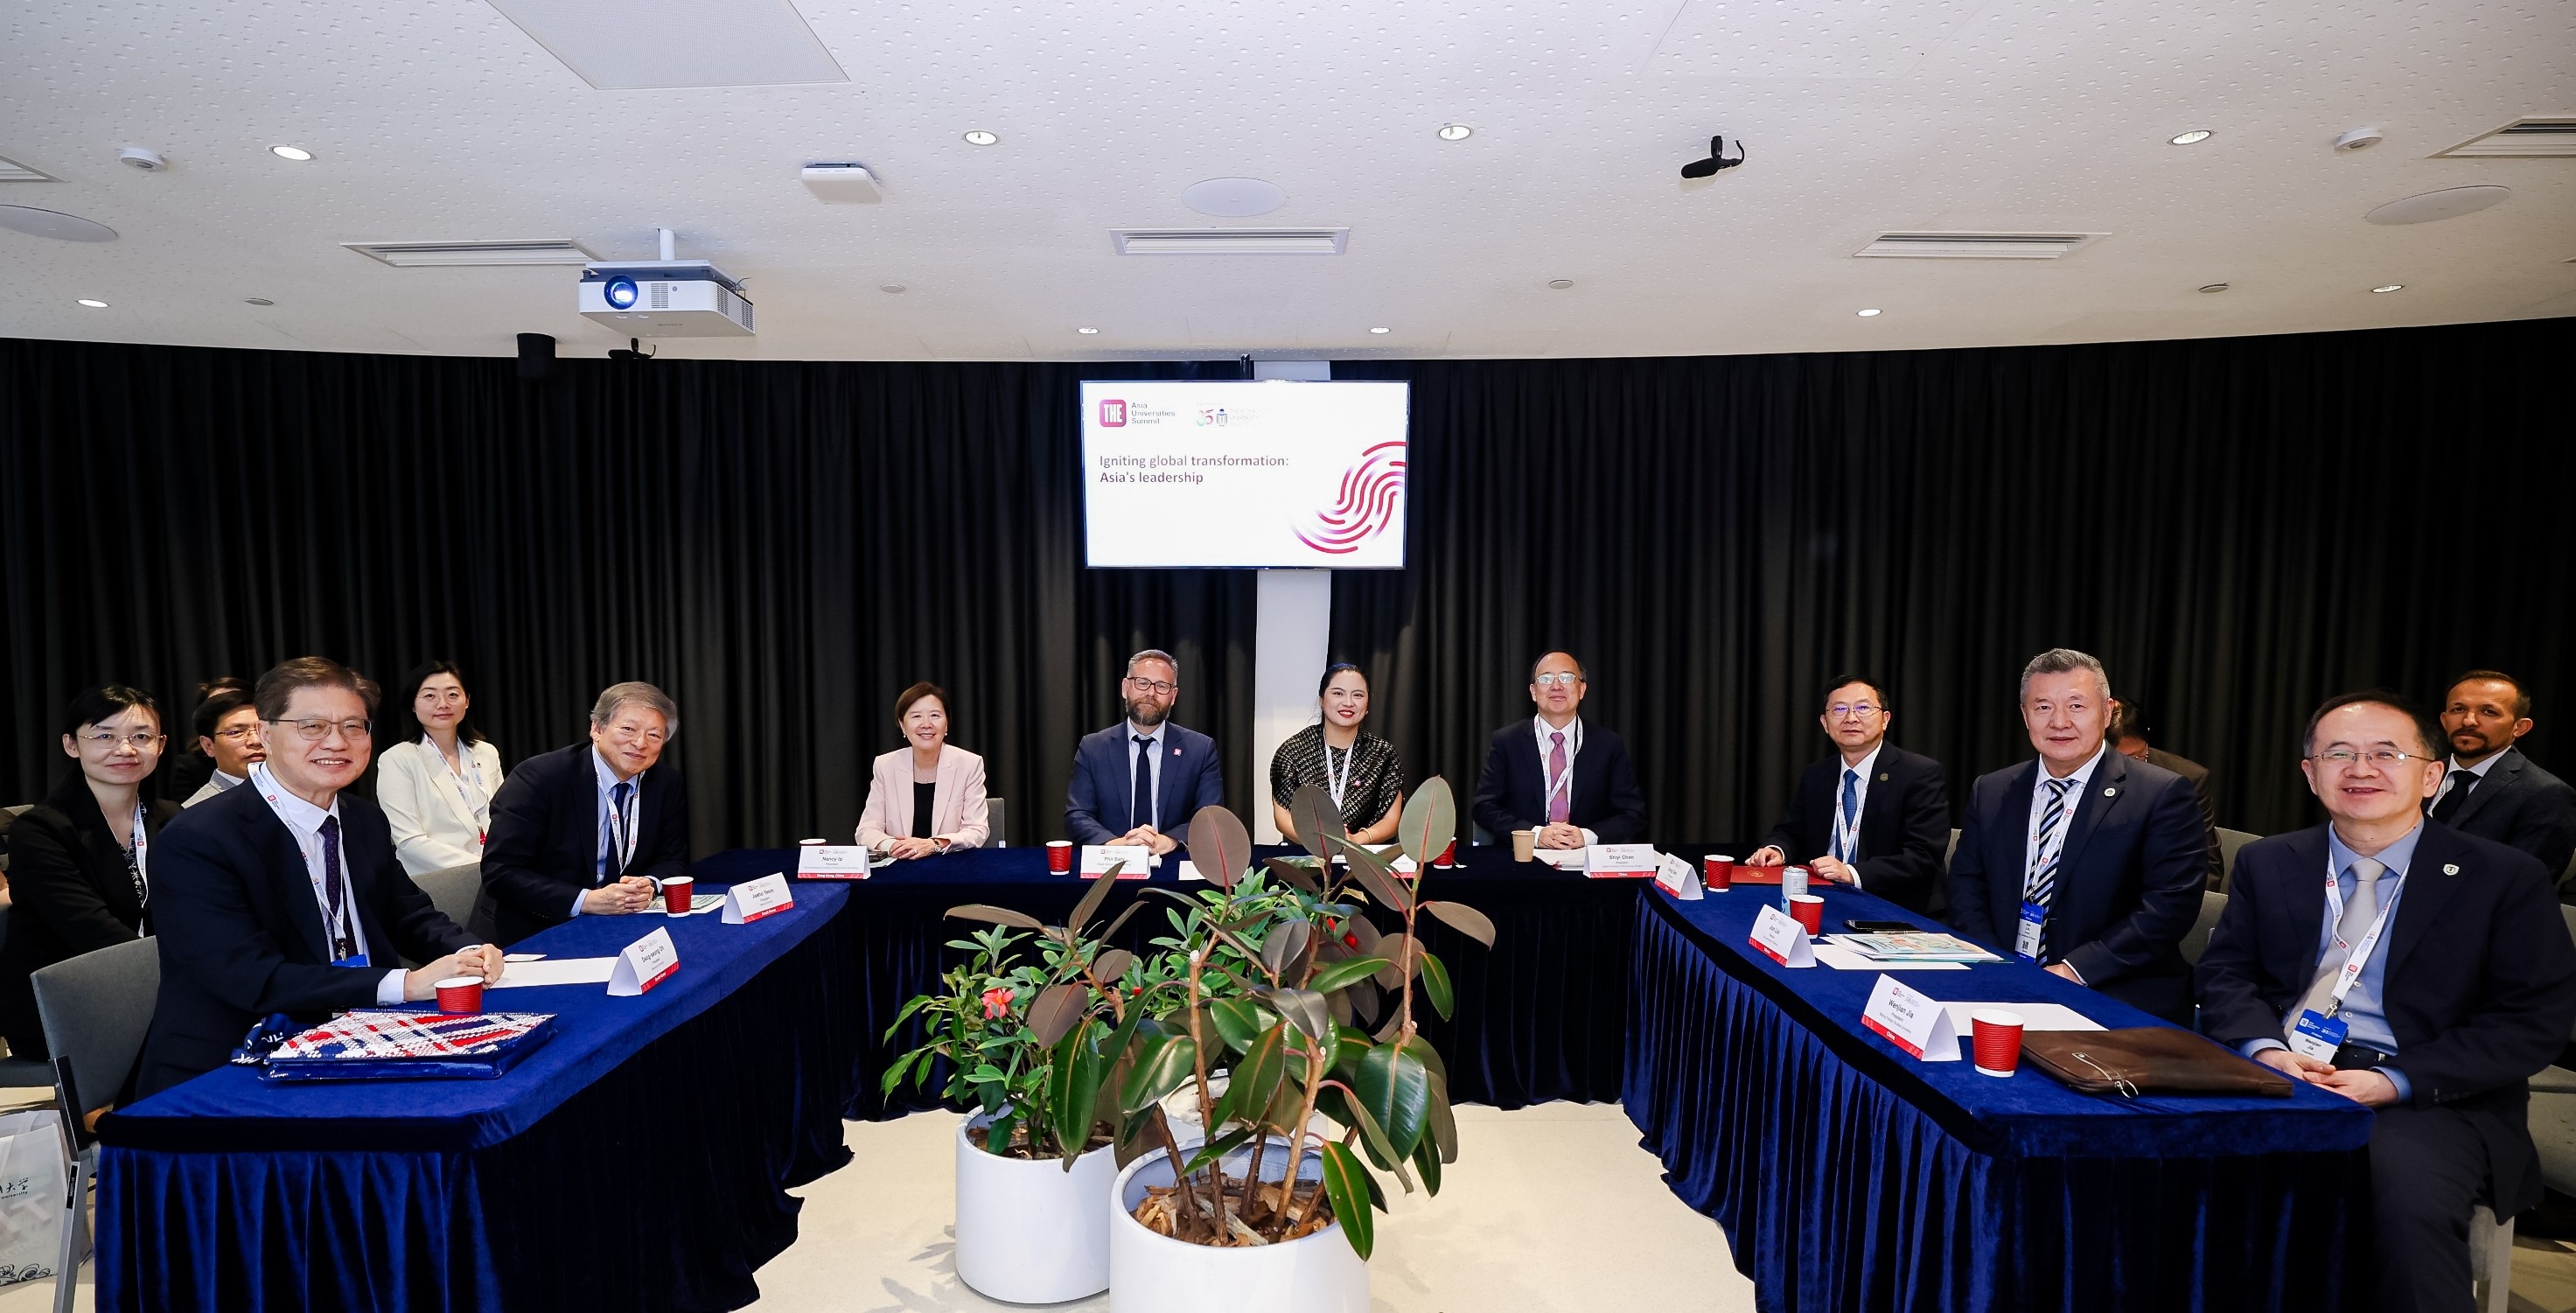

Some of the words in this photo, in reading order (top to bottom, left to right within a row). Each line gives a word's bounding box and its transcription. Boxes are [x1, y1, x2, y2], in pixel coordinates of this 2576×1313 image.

[1104, 403, 1123, 423] THE
[1100, 455, 1147, 468] Igniting
[1149, 455, 1187, 468] global
[1190, 455, 1289, 466] transformation:
[1100, 471, 1135, 483] Asia's
[1139, 471, 1204, 485] leadership
